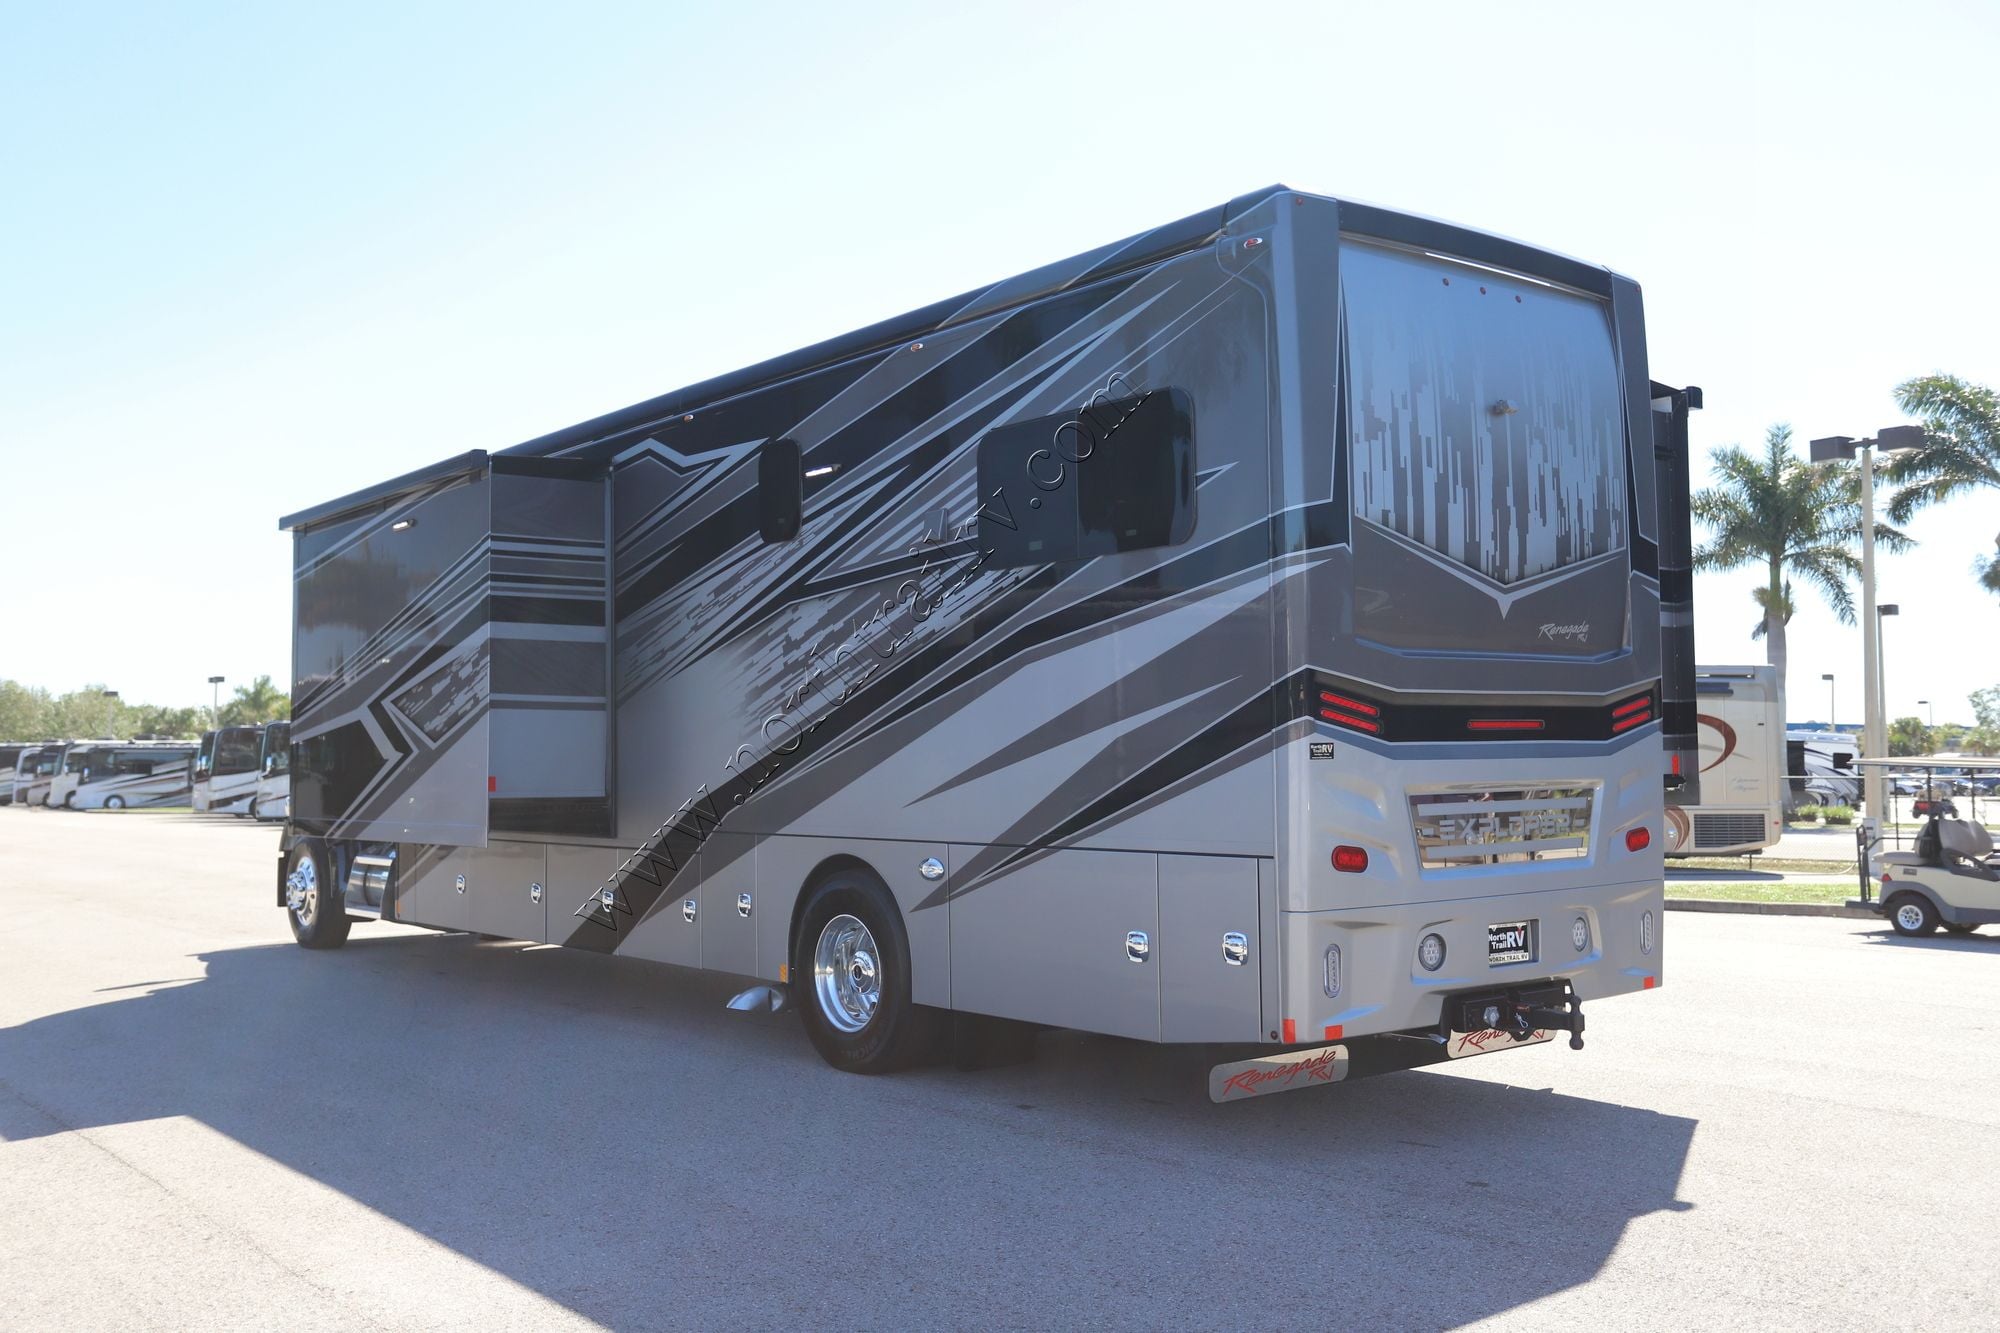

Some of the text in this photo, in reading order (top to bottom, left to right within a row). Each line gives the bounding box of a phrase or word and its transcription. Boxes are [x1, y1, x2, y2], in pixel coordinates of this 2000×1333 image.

[1538, 620, 1589, 640] Renegade
[1439, 814, 1570, 840] EXPLORER
[1488, 930, 1525, 948] North RV
[1492, 941, 1507, 950] Trail
[1223, 1049, 1336, 1096] Renegade
[1308, 1064, 1335, 1081] RV
